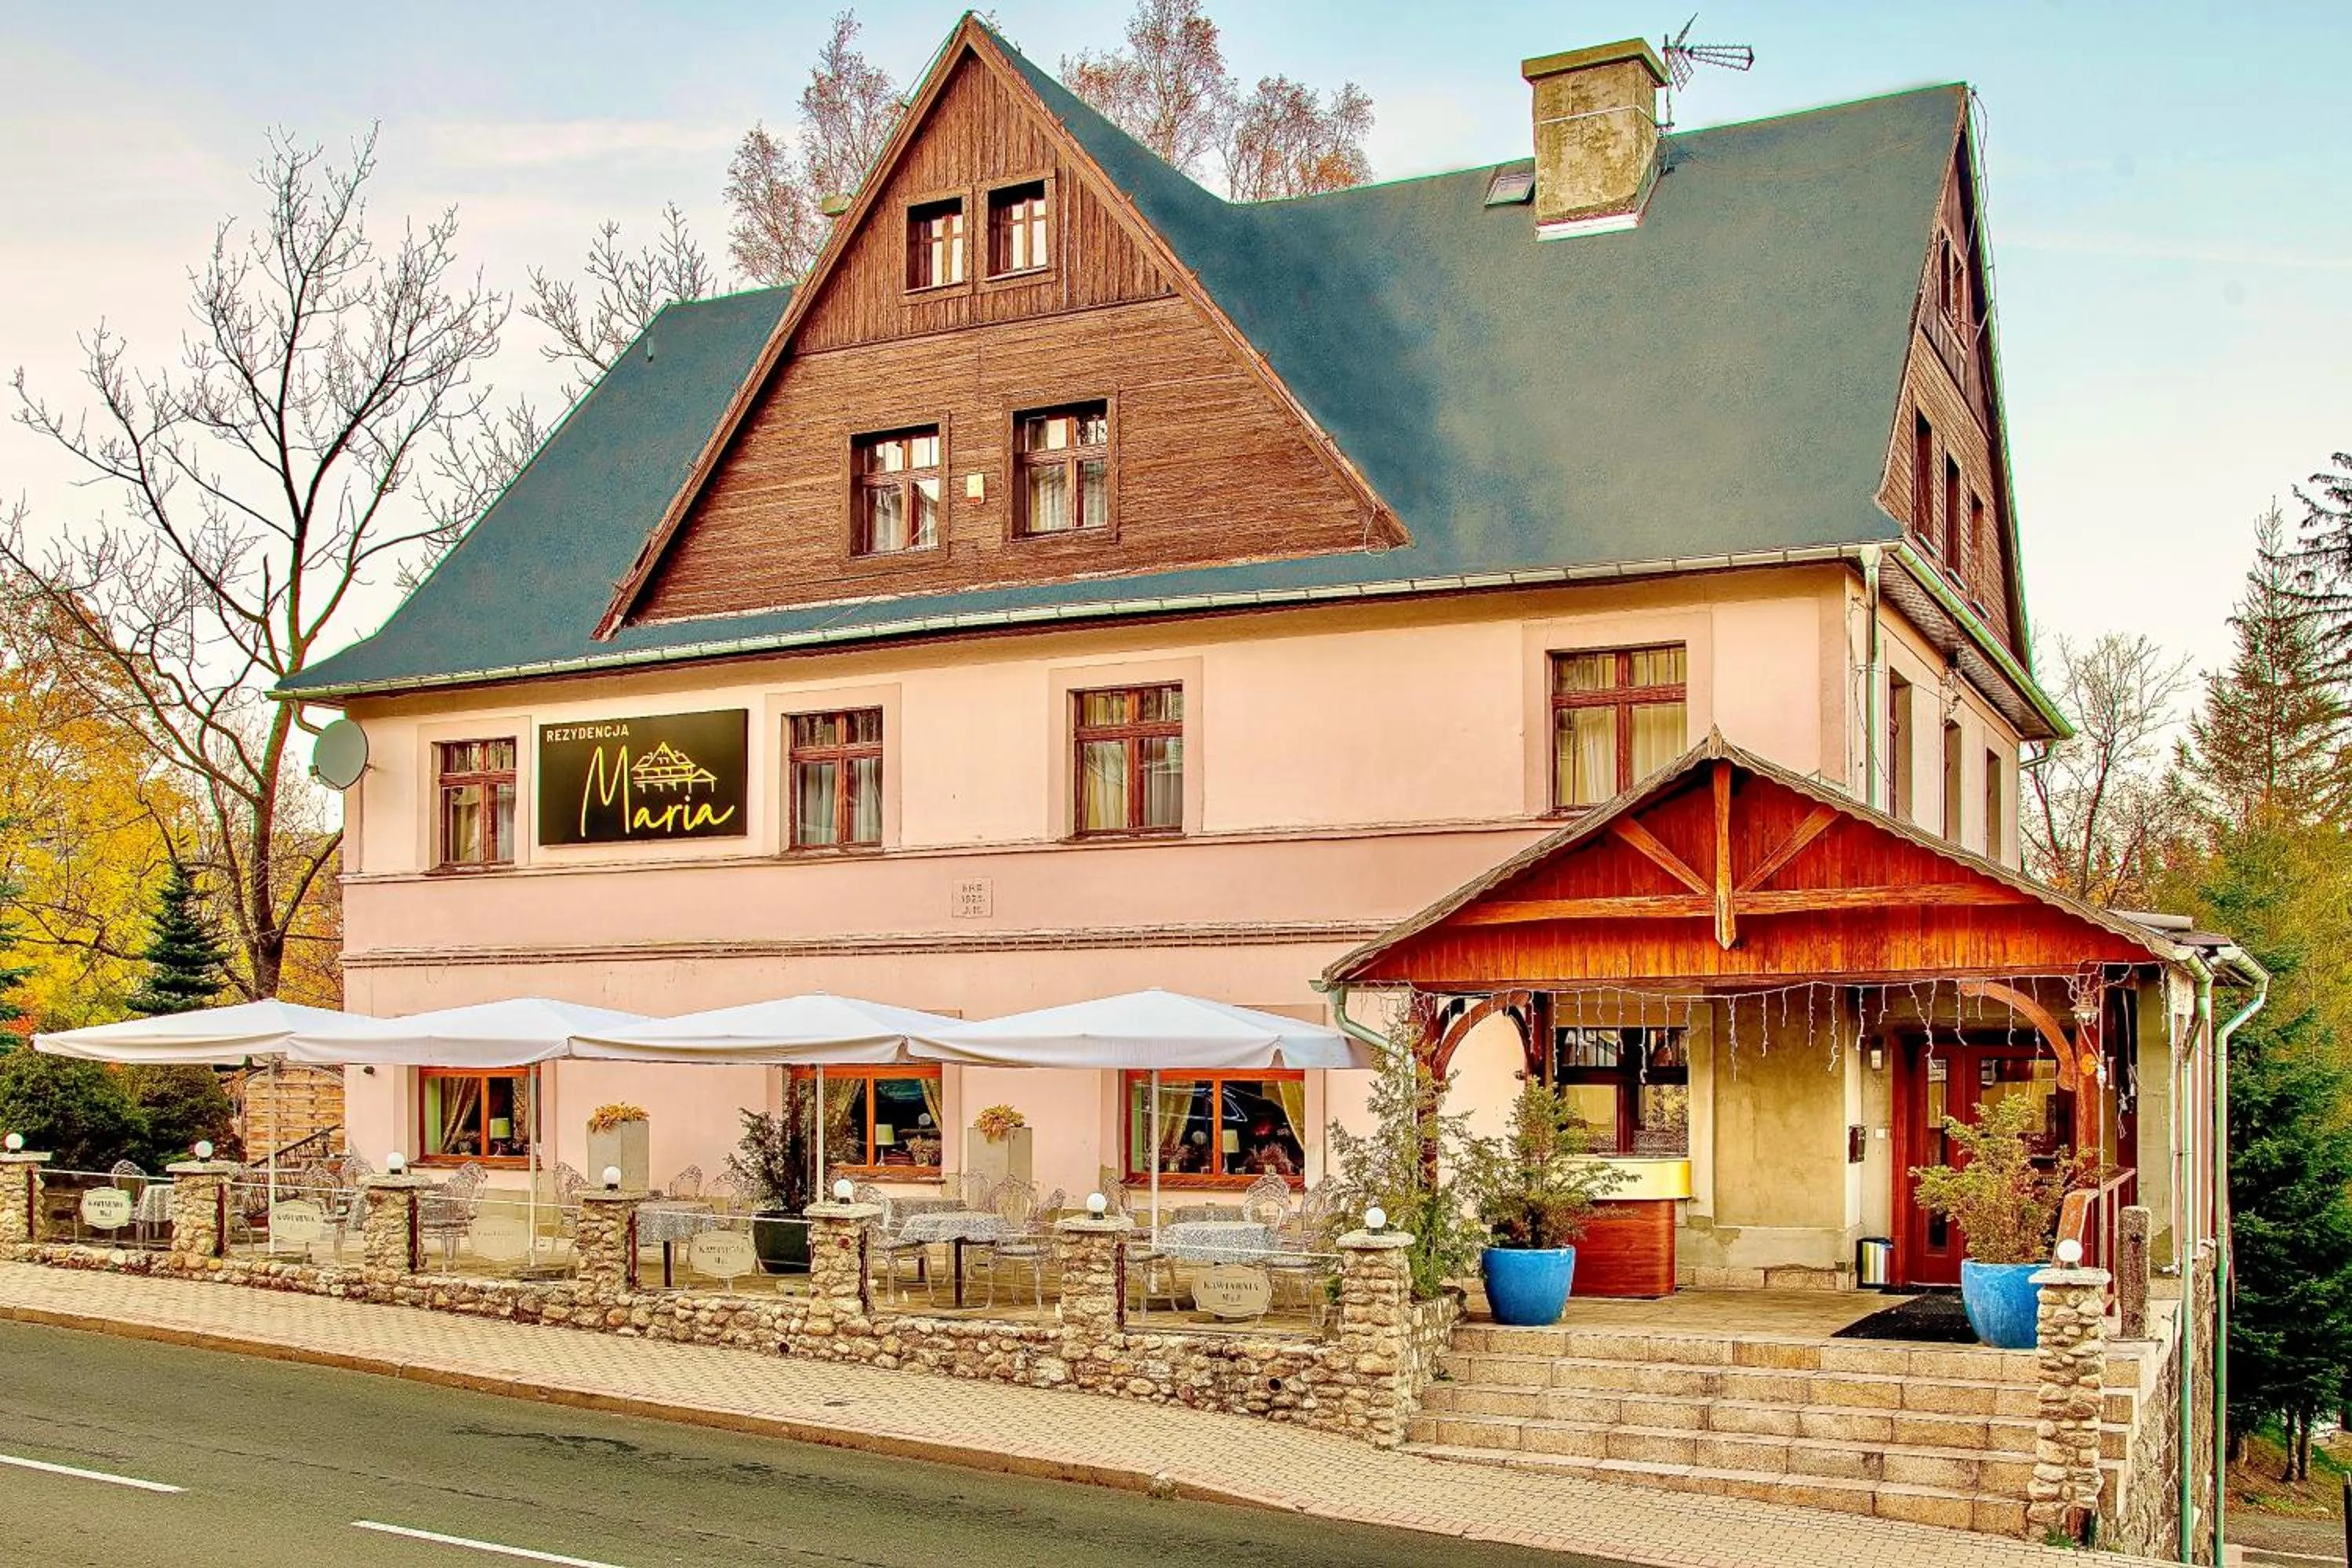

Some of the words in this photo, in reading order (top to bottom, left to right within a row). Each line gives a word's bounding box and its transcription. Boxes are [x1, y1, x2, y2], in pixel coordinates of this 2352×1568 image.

[546, 724, 630, 742] REZYDENCJA
[580, 745, 735, 837] Maria
[1203, 1279, 1259, 1292] KAWIARNIA
